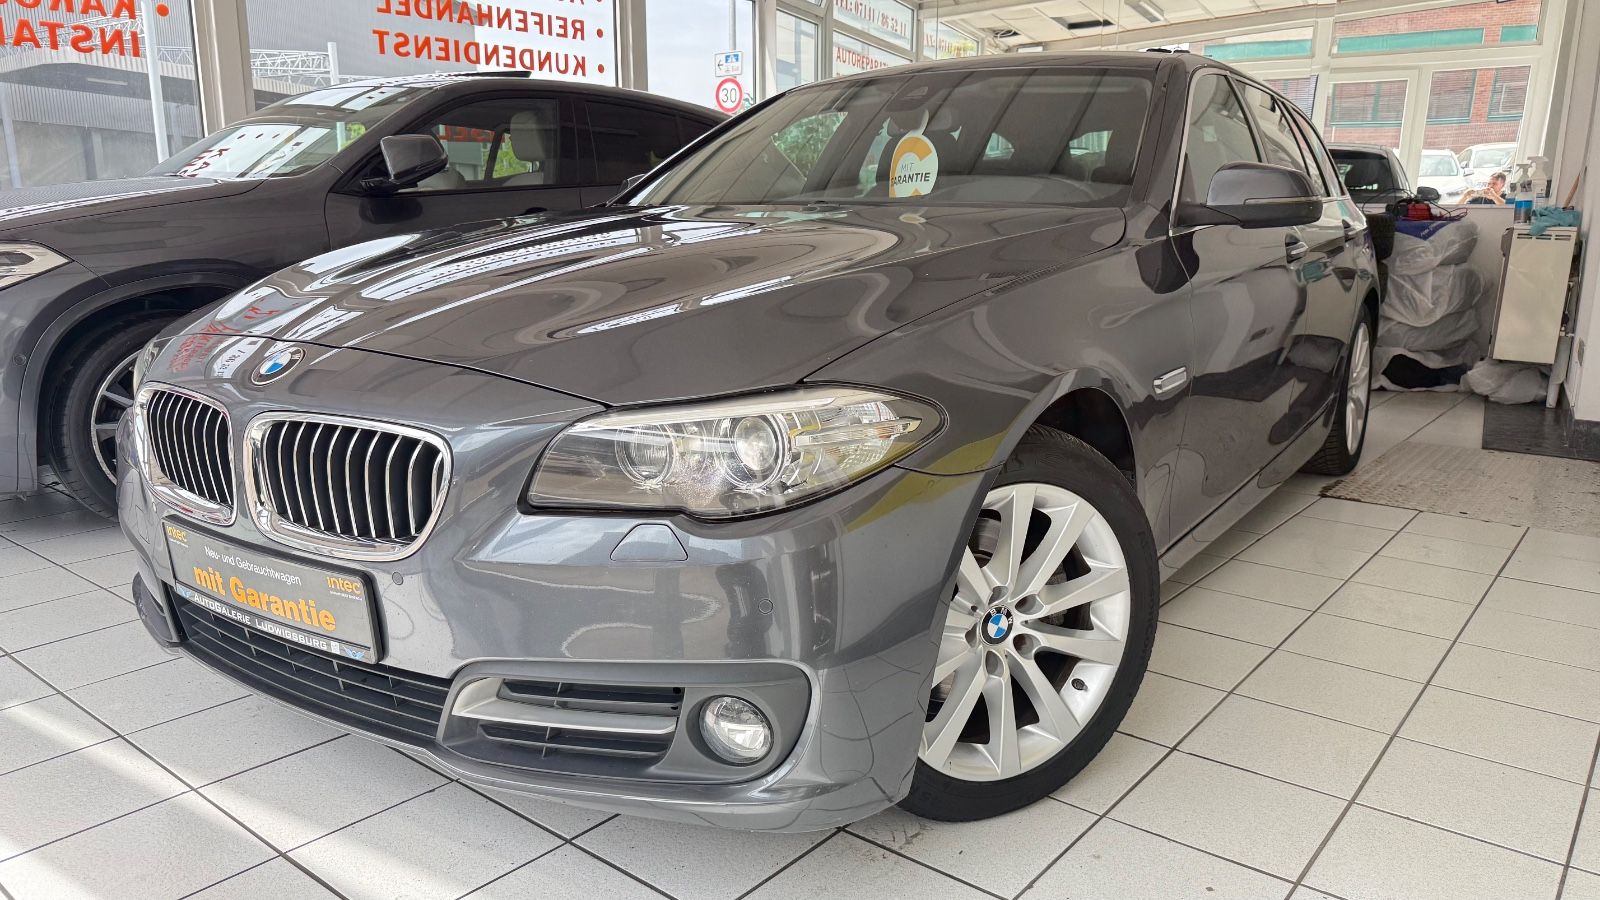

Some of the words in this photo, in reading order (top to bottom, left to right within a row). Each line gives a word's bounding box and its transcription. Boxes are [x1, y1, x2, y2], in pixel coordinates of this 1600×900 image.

[721, 87, 738, 104] 30
[901, 162, 915, 173] MIT
[204, 546, 221, 560] Neu-
[221, 553, 236, 566] und
[235, 557, 302, 586] Gebrauchtwagen
[326, 576, 361, 595] intec
[192, 565, 227, 597] mit
[229, 575, 337, 632] Garantie
[989, 607, 1013, 625] BMW
[255, 619, 328, 650] LUDWIGSBURG
